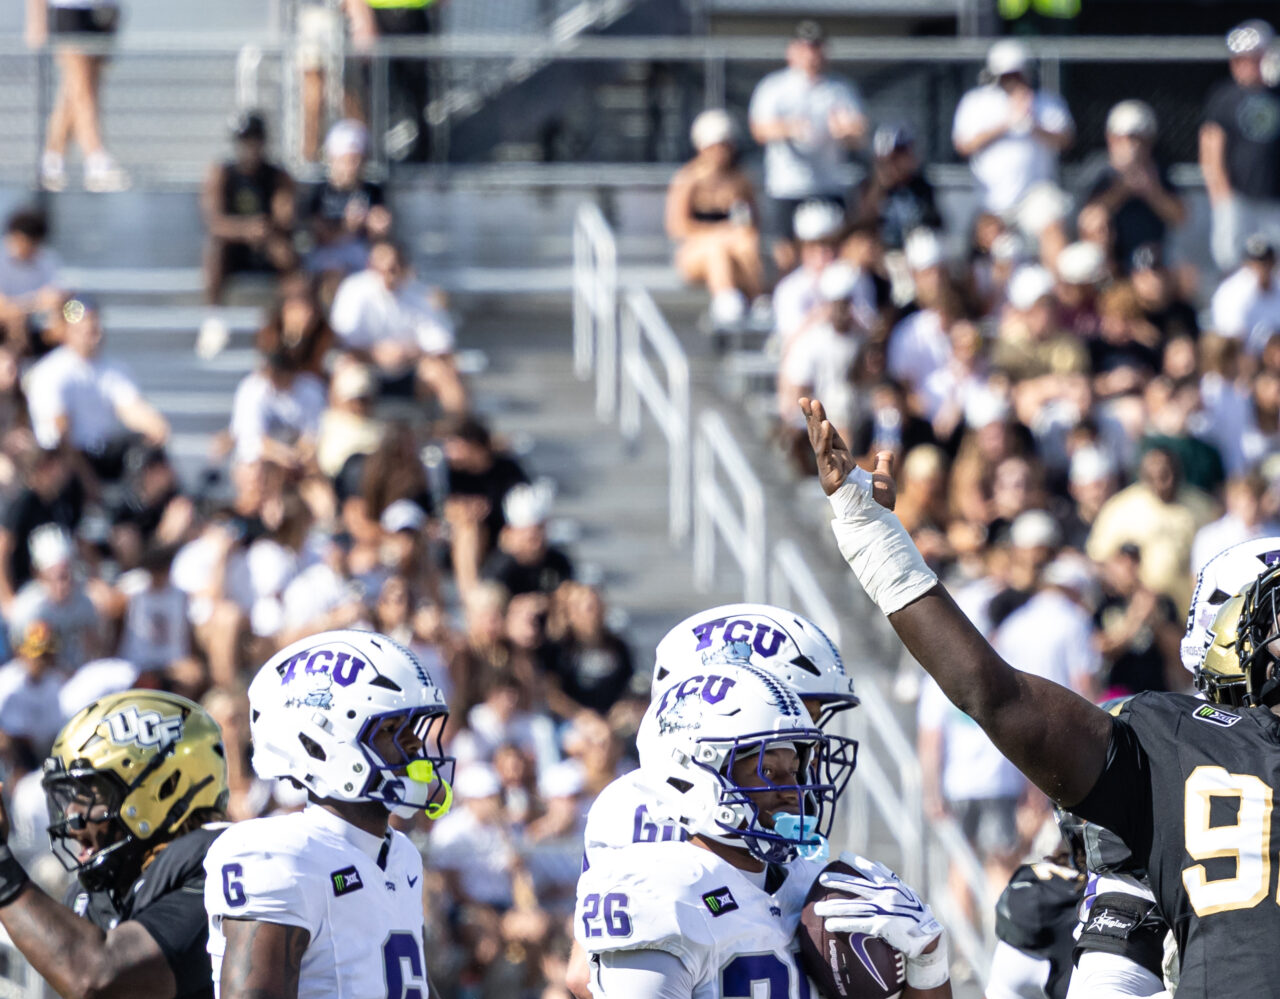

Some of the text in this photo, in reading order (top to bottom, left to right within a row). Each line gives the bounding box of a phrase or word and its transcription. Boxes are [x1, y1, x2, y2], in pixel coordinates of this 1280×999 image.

[692, 619, 787, 659] TCU
[278, 650, 366, 688] TCU
[656, 674, 737, 719] TCU
[101, 704, 185, 751] UCF
[221, 862, 249, 909] 6
[582, 892, 634, 939] 26
